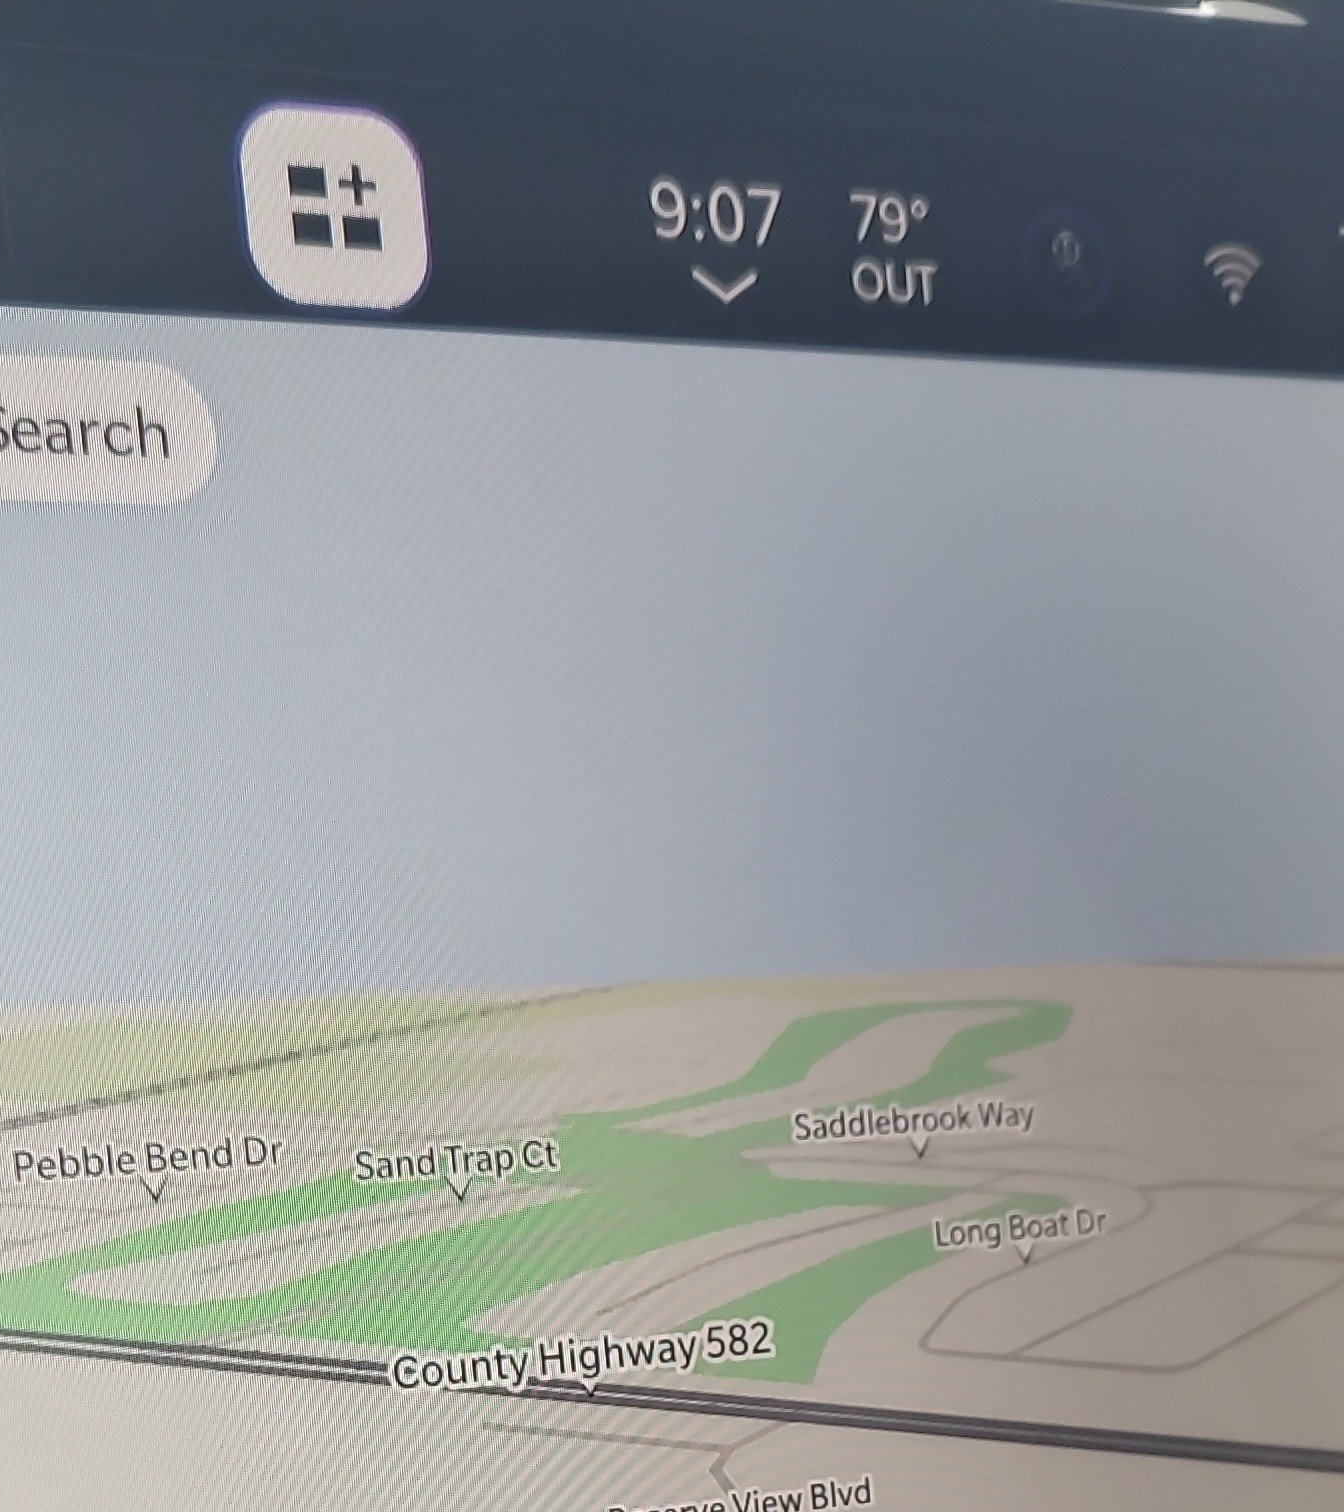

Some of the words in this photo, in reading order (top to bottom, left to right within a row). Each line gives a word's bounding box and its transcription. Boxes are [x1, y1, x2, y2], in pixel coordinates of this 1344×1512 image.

[649, 180, 783, 247] 9:07
[849, 192, 931, 244] 79°
[852, 261, 937, 306] OUT
[793, 1104, 970, 1142] Saddlebrook
[977, 1101, 1035, 1134] Way
[12, 1144, 136, 1182] Pebble
[145, 1136, 233, 1173] Bend
[243, 1134, 285, 1167] Dr
[354, 1147, 437, 1182] Sand
[444, 1143, 516, 1179] Trap
[522, 1139, 558, 1171] Ct
[934, 1216, 1002, 1252] Long
[1007, 1212, 1071, 1243] Boat
[1076, 1207, 1107, 1238] Dr
[391, 1348, 531, 1393] County
[538, 1336, 697, 1379] Highway
[704, 1321, 773, 1360] 582
[810, 1477, 873, 1512] Blvd
